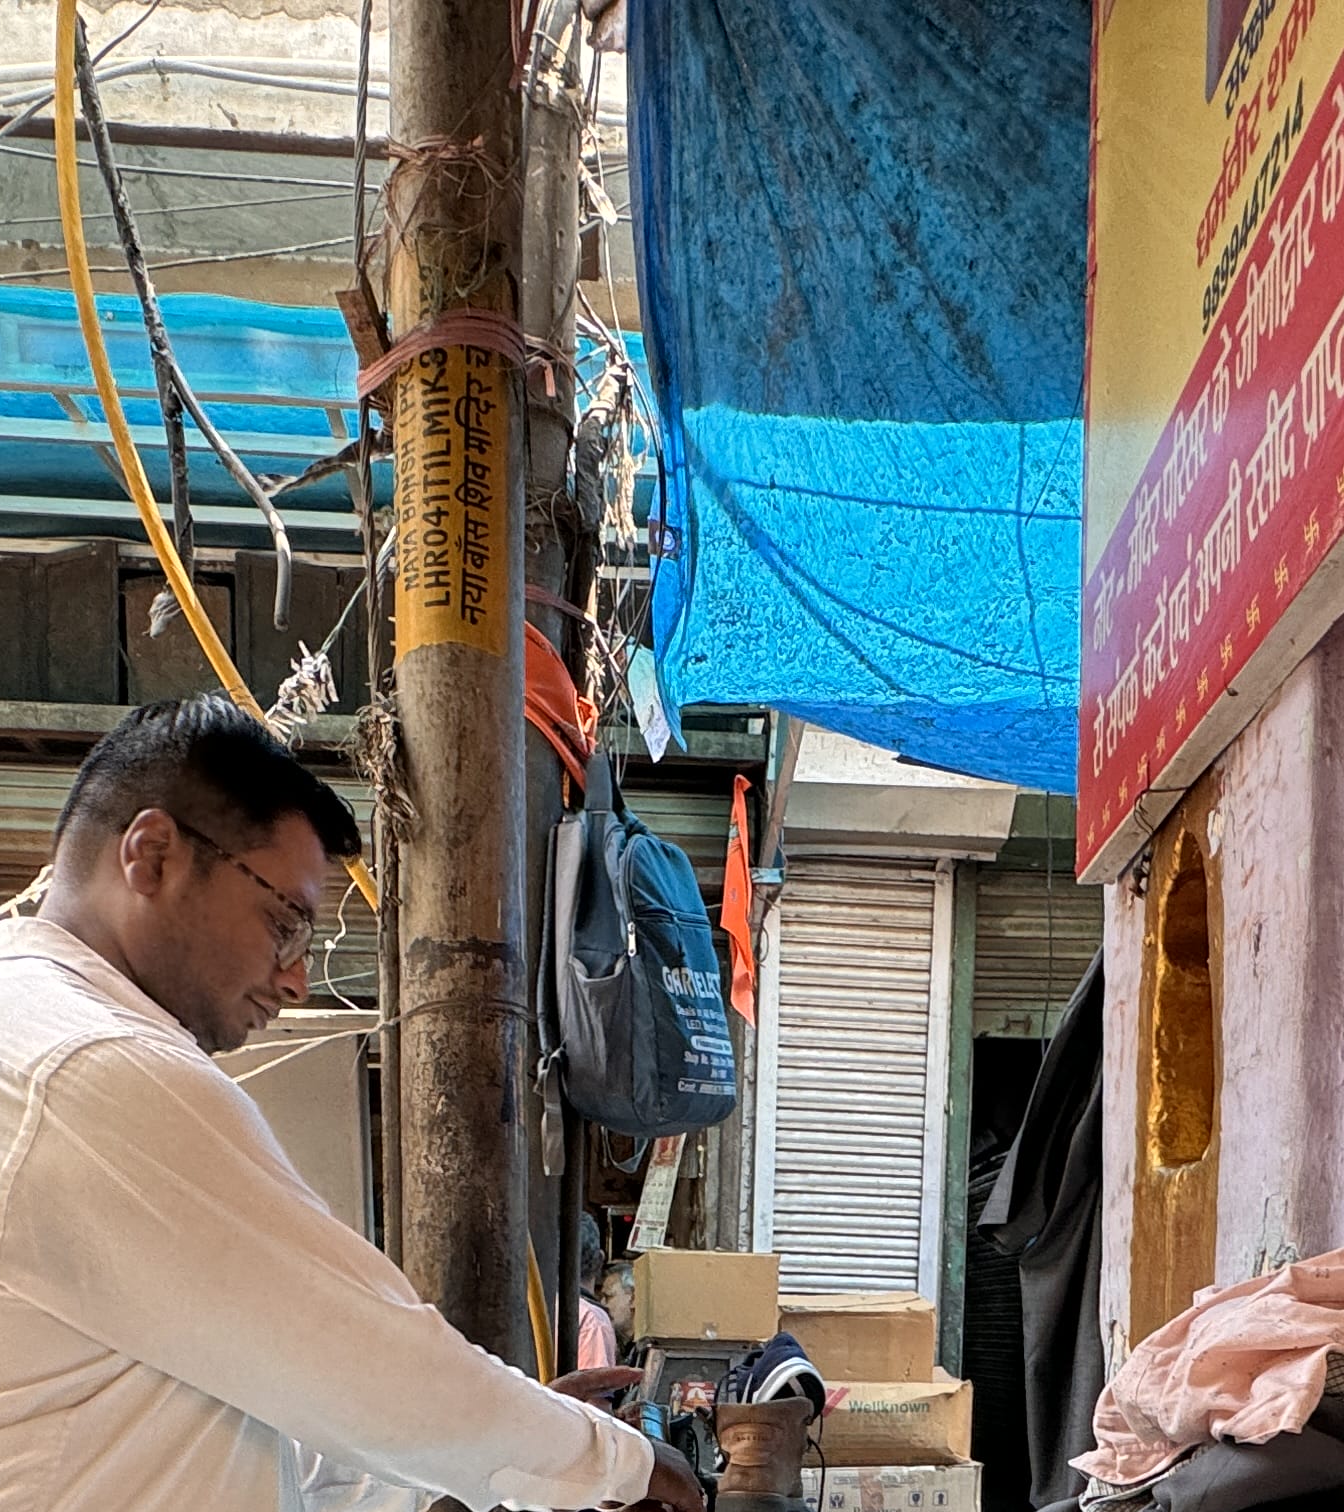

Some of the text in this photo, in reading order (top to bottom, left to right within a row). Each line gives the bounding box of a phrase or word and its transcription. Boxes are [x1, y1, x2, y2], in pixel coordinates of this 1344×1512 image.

[1202, 78, 1304, 334] 9899447214
[1211, 329, 1233, 435] के
[453, 454, 493, 511] शिव
[1168, 534, 1193, 669] एवं
[1194, 458, 1242, 628] अपनी
[1246, 388, 1298, 543] रसीद
[460, 568, 487, 626] नया
[848, 1399, 931, 1415] Wellknown
